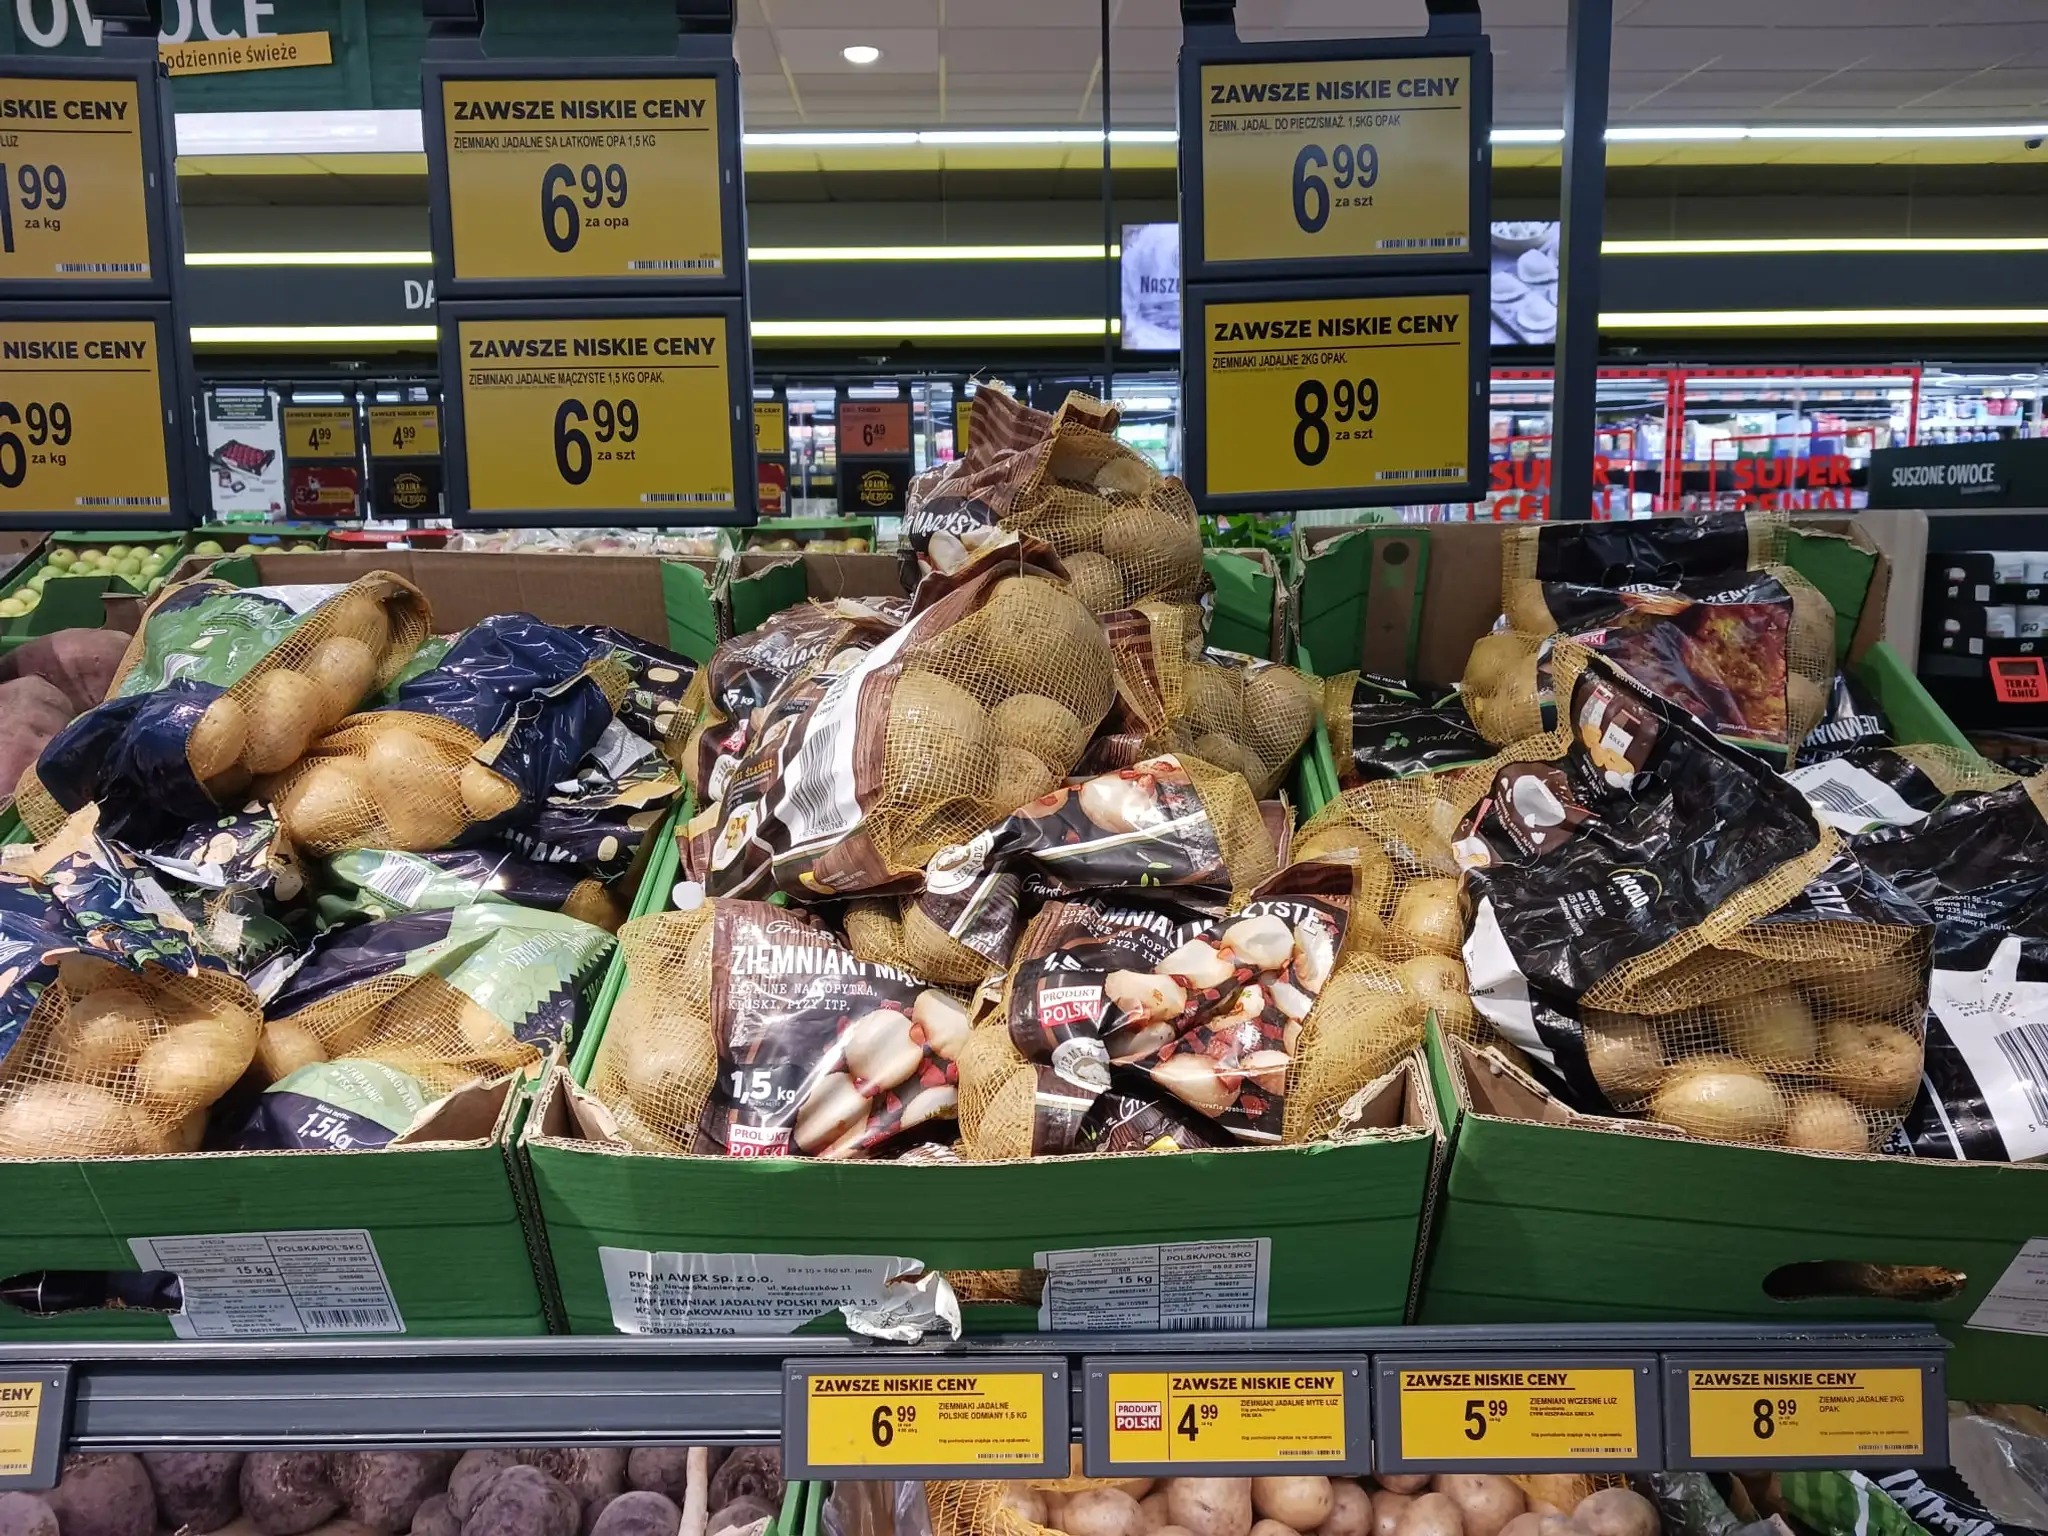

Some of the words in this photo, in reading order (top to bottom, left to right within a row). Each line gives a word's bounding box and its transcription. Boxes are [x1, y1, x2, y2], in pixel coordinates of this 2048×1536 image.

[247, 43, 298, 63] świeże
[1210, 82, 1311, 104] ZAWSZE
[1316, 80, 1391, 101] NISKIE
[1396, 77, 1460, 98] CENY
[63, 100, 128, 120] CENY
[453, 101, 555, 120] ZAWSZE
[561, 99, 637, 119] NISKIE
[643, 98, 706, 118] CENY
[1209, 119, 1240, 133] ZIEMN.
[1241, 118, 1272, 132] JADAL.
[1274, 117, 1288, 130] DO
[453, 136, 500, 149] ZIEMNIAKI
[501, 136, 543, 149] JADALNE
[606, 135, 626, 148] OPA
[628, 136, 642, 148] 1,5
[642, 135, 656, 147] KG
[18, 164, 67, 210] 99
[1292, 144, 1330, 234] 6
[1332, 143, 1379, 189] 99
[541, 163, 580, 253] 6
[581, 163, 628, 209] 99
[1335, 197, 1350, 208] za
[1353, 195, 1374, 207] szt
[25, 220, 40, 229] za
[44, 217, 61, 231] kg
[585, 218, 600, 228] za
[604, 216, 629, 229] opa
[1214, 319, 1312, 341] ZAWSZE
[1317, 317, 1392, 337] NISKIE
[1397, 314, 1460, 334] CENY
[3, 341, 78, 359] NISKIE
[84, 341, 147, 359] CENY
[469, 339, 568, 358] ZAWSZE
[573, 338, 648, 357] NISKIE
[653, 336, 716, 356] CENY
[1212, 355, 1256, 369] ZIEMNIAKI
[1258, 354, 1299, 367] JADALNE
[1301, 353, 1319, 365] 2KG
[1321, 352, 1348, 364] OPAK.
[469, 373, 513, 386] ZIEMNIAKI
[515, 372, 556, 385] JADALNE
[558, 372, 606, 387] MĄCZYSTE
[608, 372, 620, 385] 1,5
[622, 372, 635, 384] KG
[637, 371, 665, 384] OPAK.
[26, 402, 72, 446] 99
[1293, 379, 1330, 466] 8
[1333, 378, 1379, 423] 99
[554, 398, 592, 486] 6
[592, 399, 639, 443] 99
[863, 424, 874, 447] 6
[1335, 430, 1350, 441] za
[1354, 428, 1374, 440] szt
[32, 454, 46, 464] za
[50, 453, 66, 466] kg
[597, 452, 612, 461] za
[616, 450, 635, 461] szt
[1734, 455, 1851, 488] SUPER
[1891, 466, 1946, 487] SUSZONE
[1947, 463, 1996, 485] OWOCE
[2004, 678, 2038, 688] TERAZ
[2006, 688, 2040, 698] TANIEJ
[1117, 931, 1134, 939] NA
[1106, 938, 1139, 952] PYZY
[731, 945, 867, 976] ZIEMNIAKI
[1043, 988, 1097, 1002] PRODUKT
[824, 1000, 851, 1012] ITP.
[1043, 1001, 1099, 1024] POLSKI
[731, 1068, 772, 1105] 1,5
[777, 1086, 797, 1104] kg
[236, 1266, 252, 1275] 15
[255, 1265, 274, 1277] kg
[629, 1270, 664, 1282] PPUH
[668, 1272, 708, 1282] AWEX
[712, 1276, 733, 1284] Sp.
[1137, 1275, 1152, 1285] kg
[659, 1298, 718, 1307] ZIEMNIAK
[720, 1299, 773, 1307] JADALNY
[861, 1299, 878, 1307] 1,5
[815, 1380, 881, 1392] ZAWSZE
[883, 1379, 933, 1391] NISKIE
[936, 1378, 977, 1391] CENY
[1172, 1378, 1238, 1390] ZAWSZE
[1241, 1377, 1291, 1390] NISKIE
[1294, 1377, 1335, 1389] CENY
[1406, 1374, 1470, 1387] ZAWSZE
[1474, 1374, 1524, 1386] NISKIE
[1527, 1373, 1568, 1386] CENY
[1694, 1374, 1760, 1386] ZAWSZE
[1763, 1373, 1813, 1386] NISKIE
[1816, 1373, 1856, 1385] CENY
[938, 1402, 975, 1410] ZIEMNIAKI
[976, 1402, 1009, 1410] JADALNE
[1118, 1405, 1158, 1414] PRODUKT
[938, 1412, 969, 1420] POLSKIE
[970, 1412, 1004, 1420] ODMIANY
[1016, 1411, 1028, 1419] KG
[1116, 1416, 1160, 1430] POLSKI
[1177, 1404, 1199, 1442] 4
[1200, 1404, 1218, 1419] 99
[1464, 1400, 1487, 1441] 5
[1488, 1400, 1508, 1417] 99
[1753, 1399, 1775, 1440] 8
[1777, 1399, 1797, 1416] 99
[872, 1406, 894, 1447] 6
[897, 1405, 916, 1422] 99
